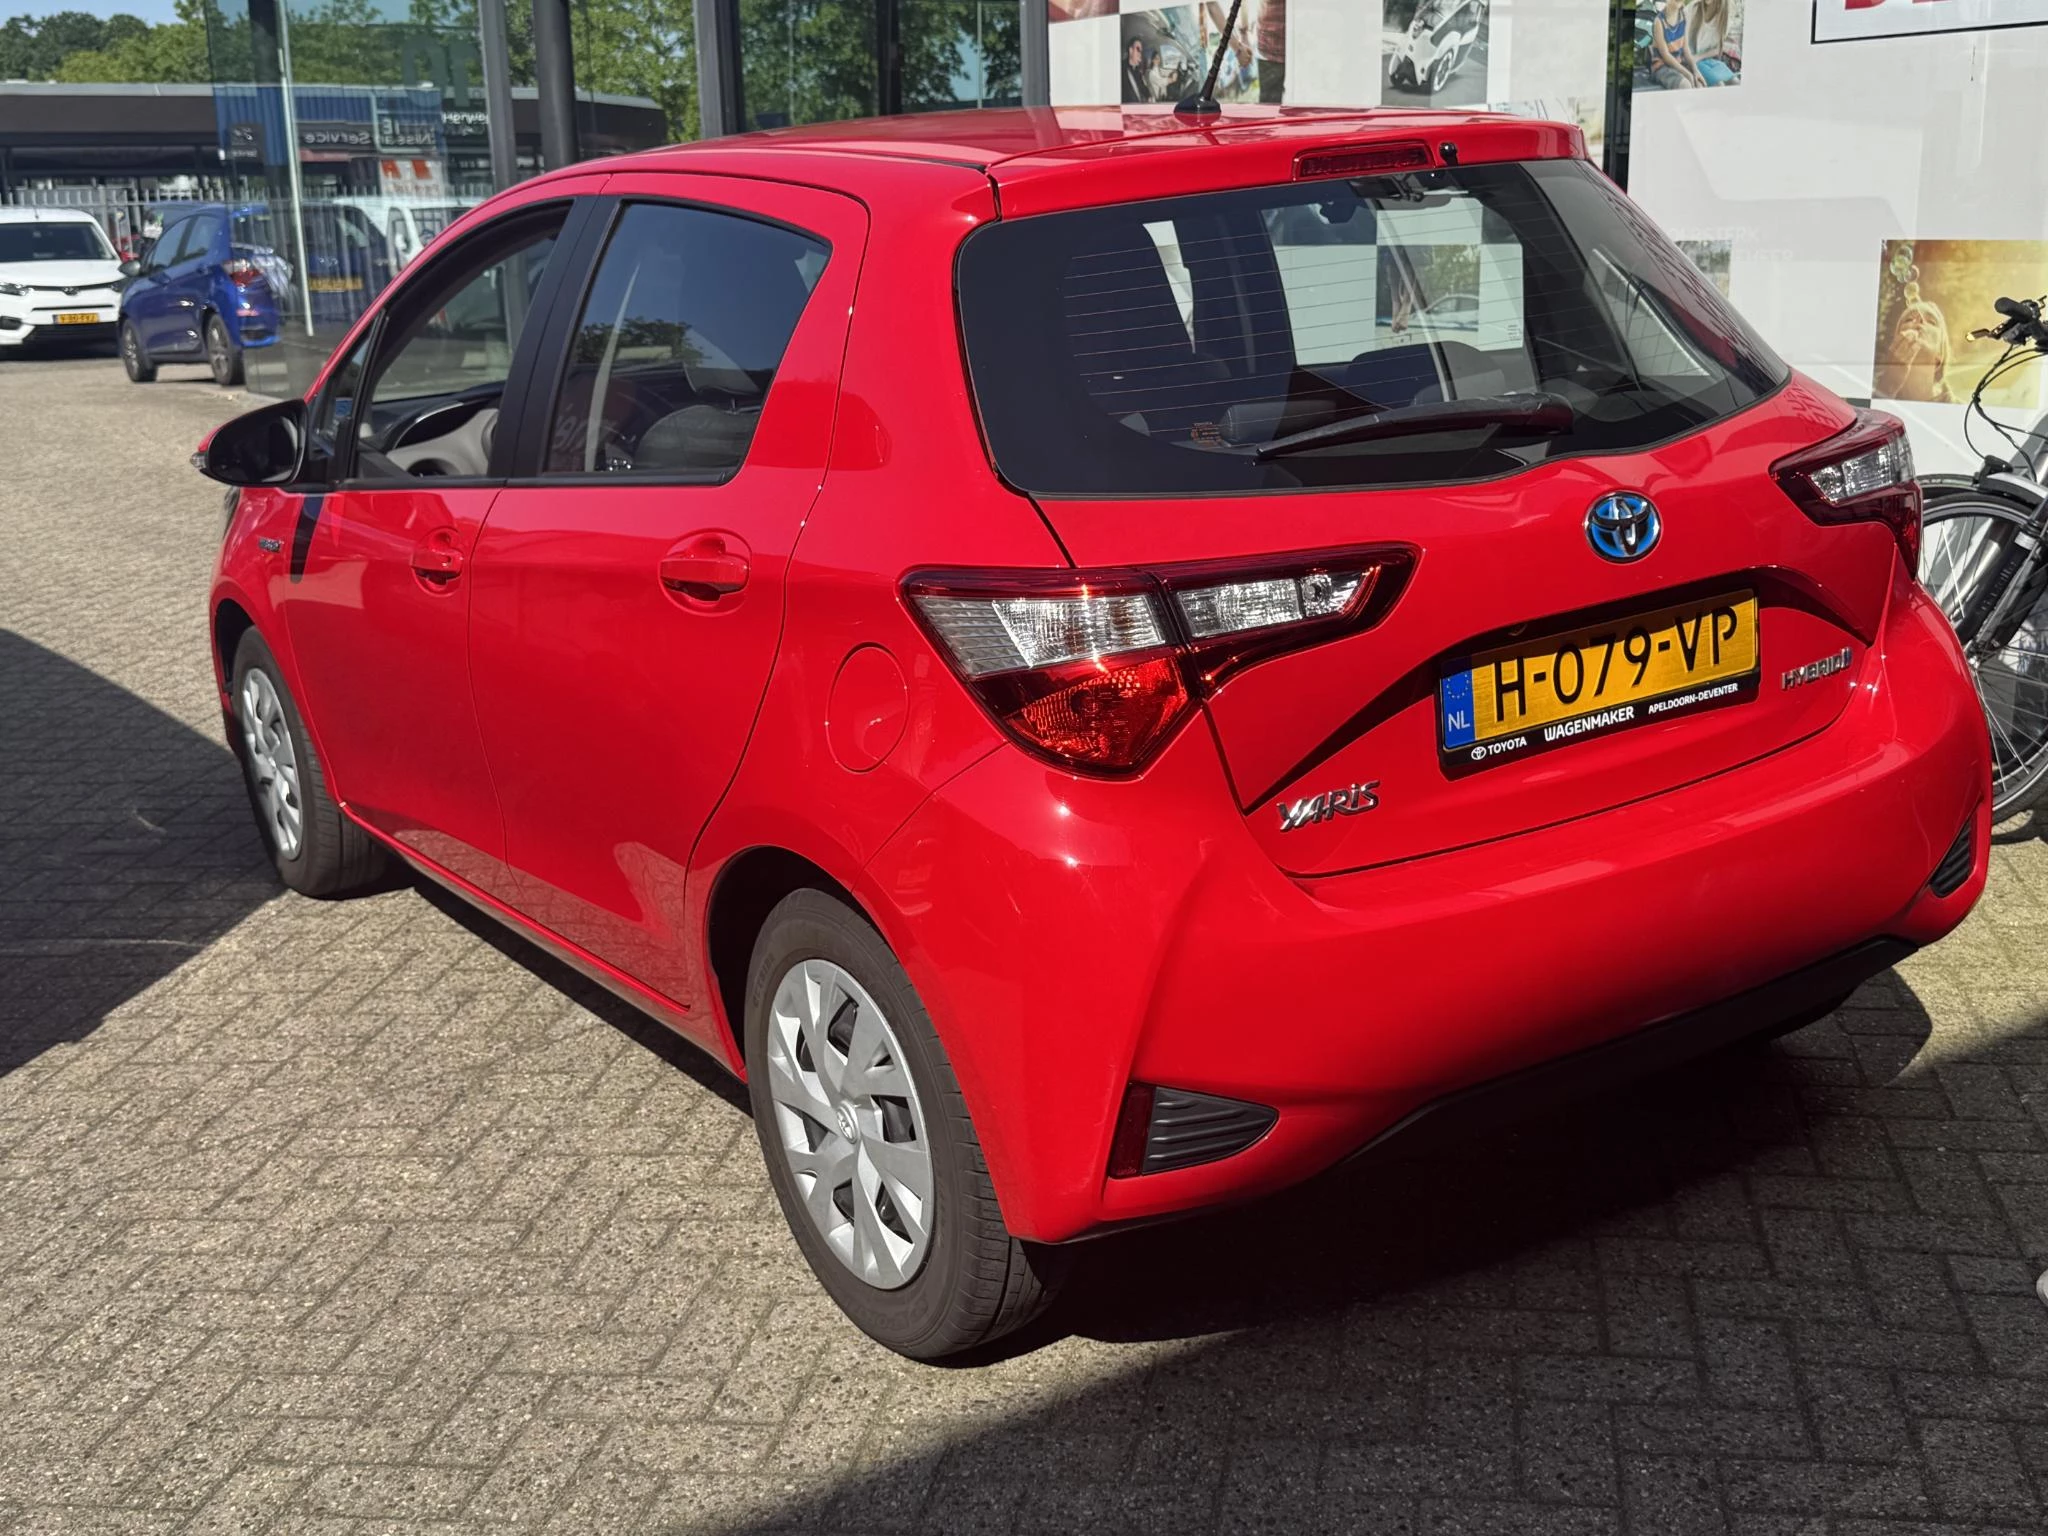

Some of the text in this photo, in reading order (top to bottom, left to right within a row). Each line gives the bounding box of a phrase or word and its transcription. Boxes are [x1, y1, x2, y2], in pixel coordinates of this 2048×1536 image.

[1494, 605, 1738, 722] H-079-VP
[1781, 647, 1852, 690] HYBRID
[1448, 710, 1471, 732] NL
[1487, 682, 1739, 756] TOYOTA WAGENMAKER APELDOORN-DEVENTER
